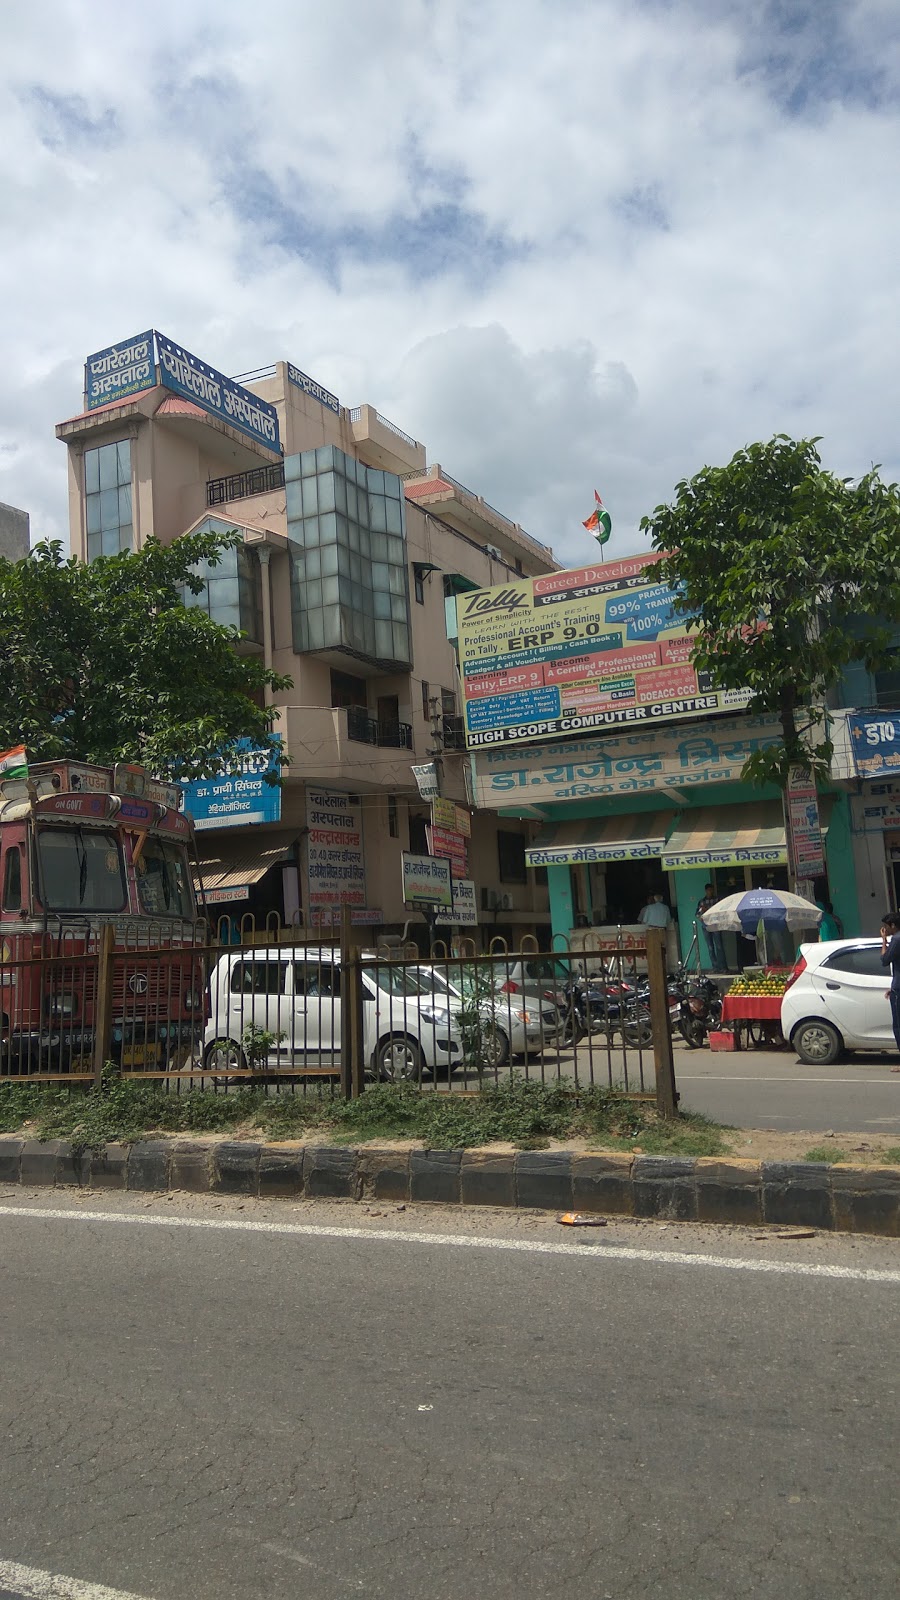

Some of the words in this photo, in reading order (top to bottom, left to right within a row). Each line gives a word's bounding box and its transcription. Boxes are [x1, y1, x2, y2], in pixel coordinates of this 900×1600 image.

[90, 340, 149, 374] प्यारेलाल
[91, 360, 150, 397] अस्पताल
[160, 347, 221, 408] प्यारेलाल
[223, 388, 276, 442] अस्पताल
[535, 576, 580, 592] Career
[541, 592, 568, 604] एक
[572, 581, 620, 597] सफल
[464, 589, 528, 614] Tally
[609, 600, 640, 617] 99%
[462, 620, 484, 629] Power
[486, 615, 493, 624] of
[495, 609, 532, 621] Simplicity
[464, 628, 516, 646] Professional
[518, 620, 562, 636] Account's
[563, 612, 601, 625] Training
[474, 623, 506, 634] LEARN
[510, 618, 536, 627] WITH
[541, 612, 559, 620] THE
[564, 606, 590, 616] BEST
[631, 613, 663, 633] 100%
[465, 648, 476, 657] on
[477, 644, 498, 656] Tally
[508, 631, 555, 652] ERP
[563, 622, 600, 641] 9.0
[465, 656, 496, 668] Advance
[498, 650, 529, 661] Account
[539, 644, 563, 654] Billing
[569, 638, 589, 648] Cash
[590, 636, 611, 644] Book
[550, 655, 590, 668] Become
[465, 664, 495, 676] Leadger
[504, 660, 514, 668] all
[515, 656, 546, 666] Voucher
[547, 669, 555, 677] A
[557, 663, 596, 676] Certified
[599, 650, 657, 668] Professional
[586, 659, 657, 678] Accountant
[467, 670, 508, 682] Learning
[530, 672, 539, 681] 9
[578, 701, 606, 710] Computer
[607, 695, 636, 704] Hardware
[640, 688, 676, 702] DOEACC
[677, 684, 696, 696] CCC
[469, 730, 505, 746] HIGH
[508, 722, 557, 739] SCOPE
[561, 708, 647, 730] COMPUTER
[651, 696, 718, 716] CENTRE
[554, 783, 614, 798] वरिष्ठ
[619, 778, 657, 790] नेत्र
[663, 766, 732, 787] सर्जन
[55, 801, 66, 809] ON
[66, 799, 84, 811] GOVT
[309, 791, 348, 810] प्यारेलाल
[310, 811, 355, 828] अस्पताल
[529, 851, 570, 865] सिंघल
[572, 848, 627, 862] मैडिकल
[629, 844, 662, 858] स्टोर
